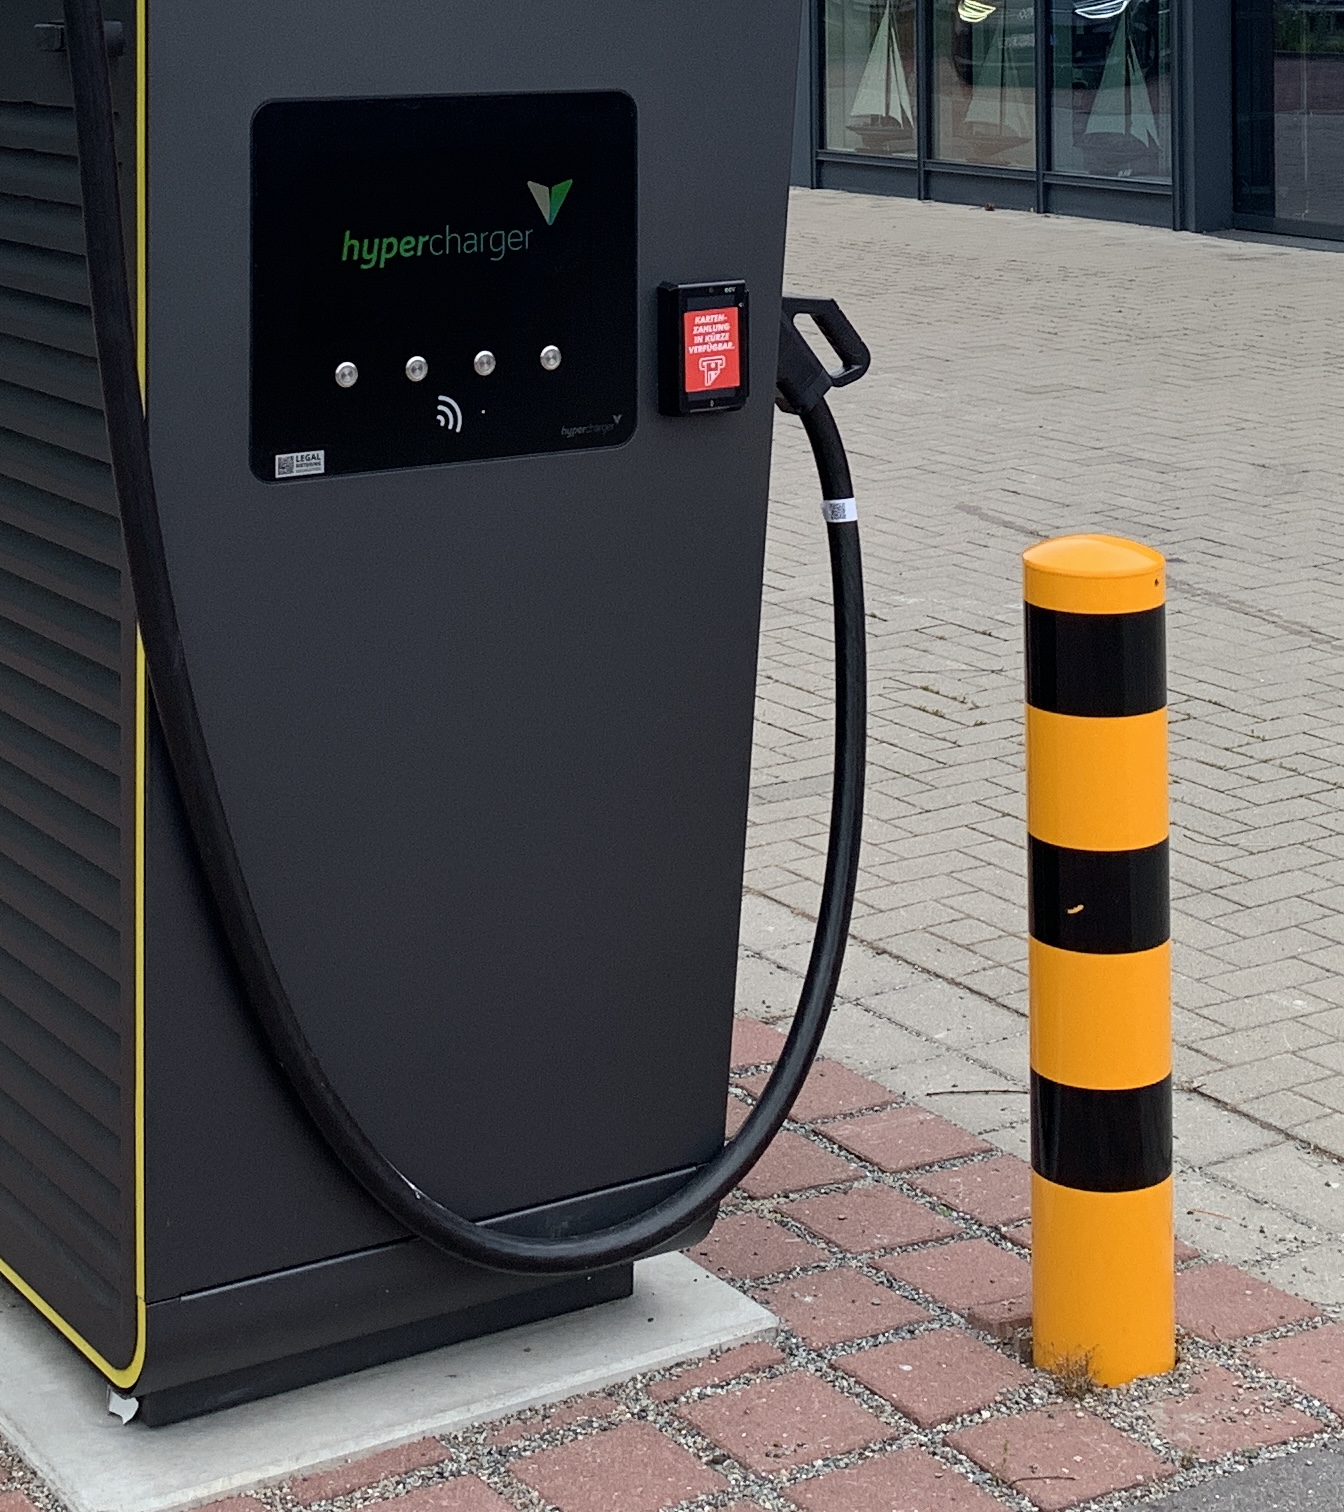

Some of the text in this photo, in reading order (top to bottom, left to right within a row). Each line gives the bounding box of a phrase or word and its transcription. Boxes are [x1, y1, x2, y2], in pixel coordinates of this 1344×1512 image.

[341, 224, 534, 270] hypercharger
[694, 313, 727, 324] KARTEN-
[693, 323, 730, 334] ZAHLUNG
[705, 332, 730, 342] KÜRZE
[295, 452, 321, 462] LEGAL
